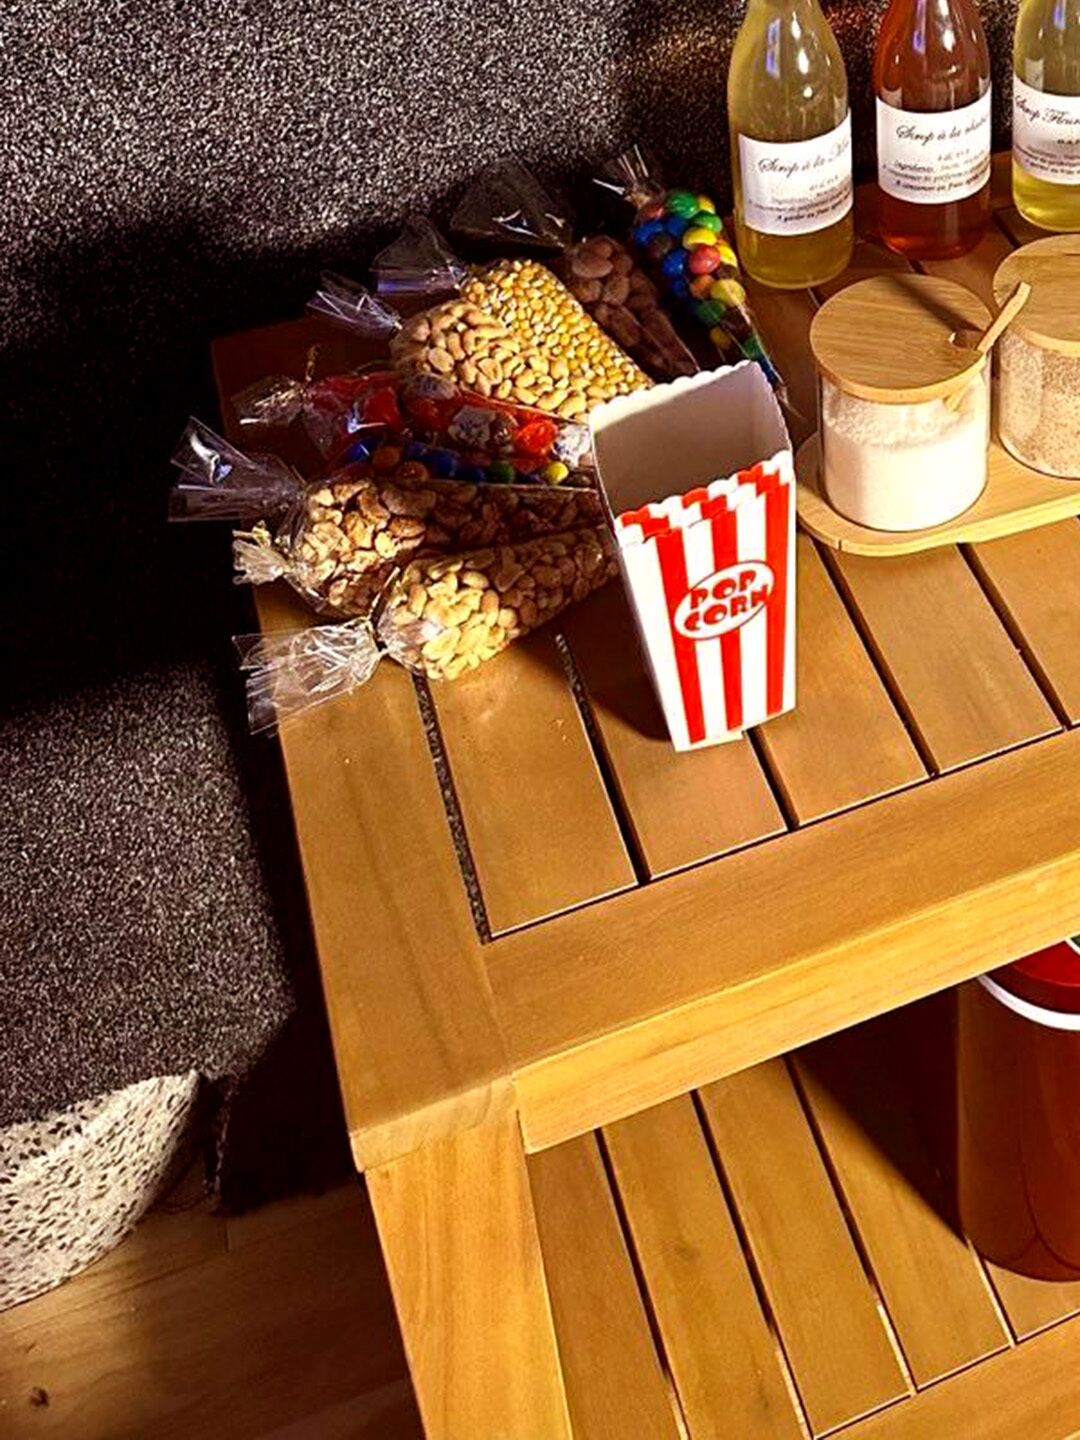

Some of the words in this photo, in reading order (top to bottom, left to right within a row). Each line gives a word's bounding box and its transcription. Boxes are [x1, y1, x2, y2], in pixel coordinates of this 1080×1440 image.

[896, 125, 935, 146] Sirop
[758, 157, 799, 178] Sirop
[690, 570, 757, 609] POP
[684, 584, 769, 632] CORN
